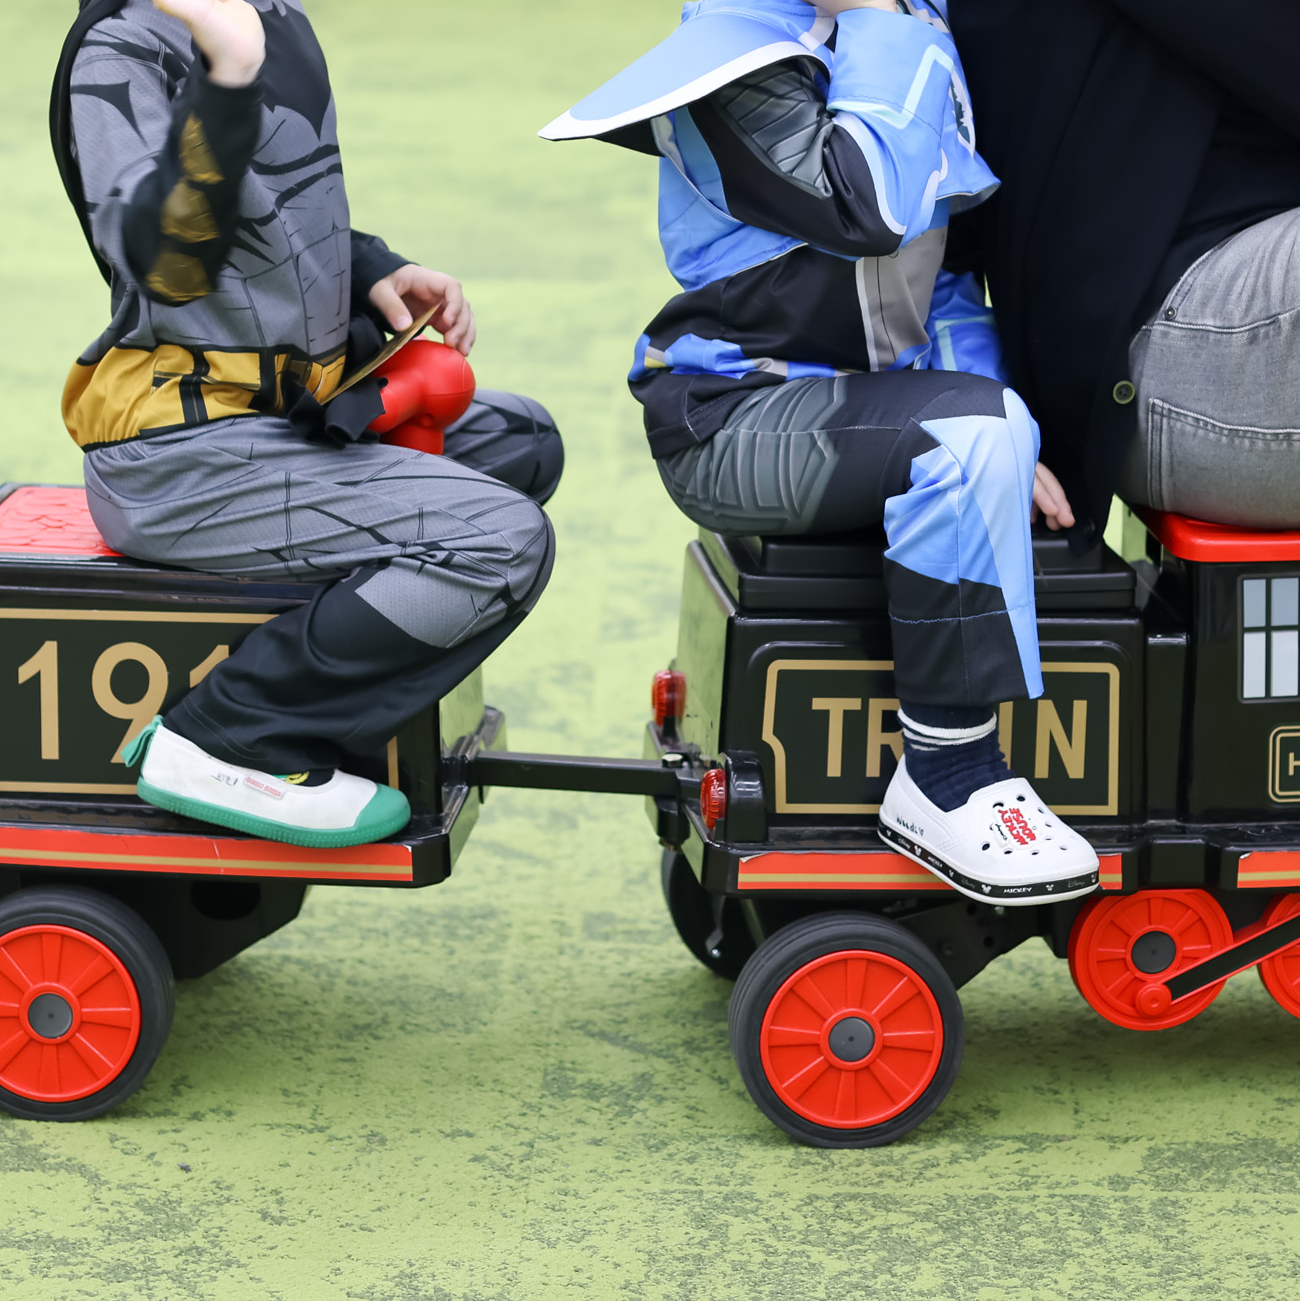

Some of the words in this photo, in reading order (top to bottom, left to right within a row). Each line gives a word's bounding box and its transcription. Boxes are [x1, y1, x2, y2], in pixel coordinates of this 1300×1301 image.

[18, 640, 230, 763] 19
[811, 697, 1088, 779] TRIN
[1002, 886, 1033, 895] MICKEY
